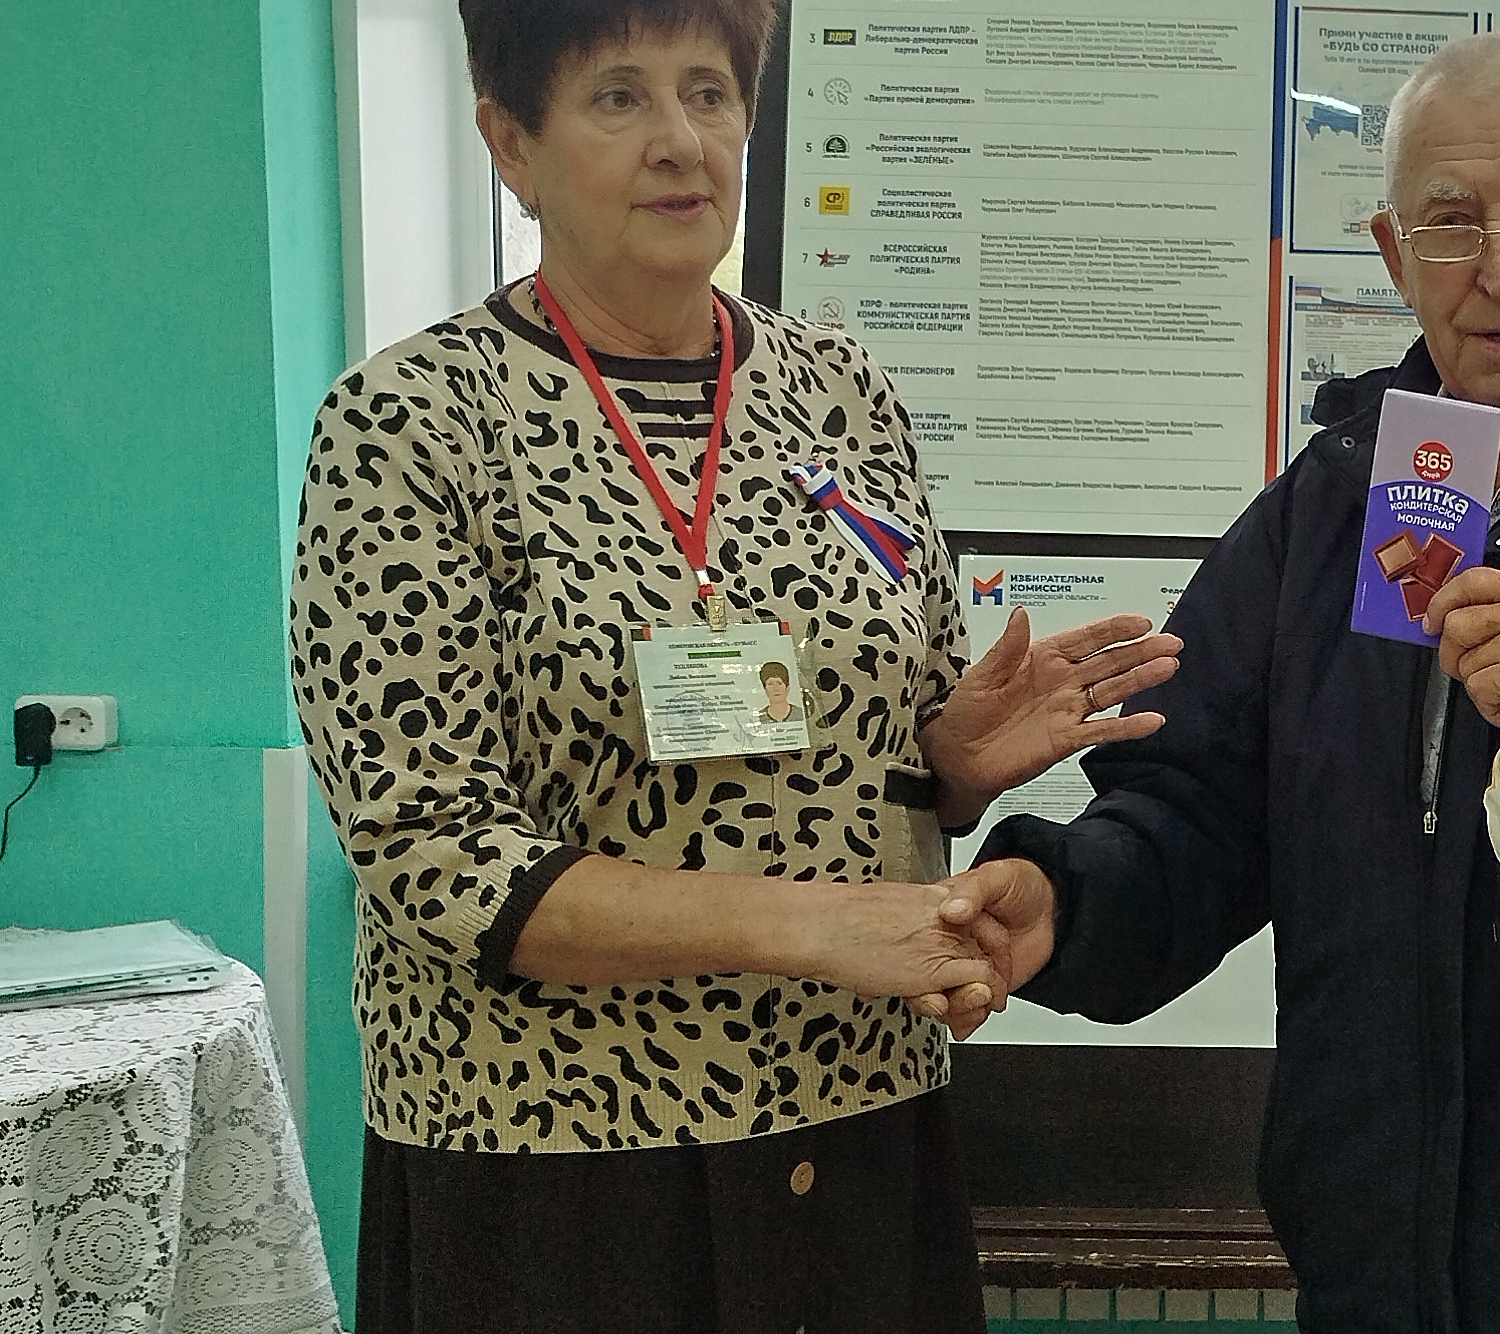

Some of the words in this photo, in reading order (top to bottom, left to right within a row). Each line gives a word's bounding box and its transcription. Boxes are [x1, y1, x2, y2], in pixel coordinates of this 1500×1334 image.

[948, 25, 970, 34] ЛДПР
[1318, 27, 1356, 38] Прими
[1358, 30, 1404, 40] участие
[1414, 34, 1448, 42] акции
[809, 33, 816, 44] 3
[1322, 41, 1360, 52] «БУДЬ
[1361, 42, 1379, 52] СО
[807, 89, 814, 98] 4
[805, 143, 813, 153] 5
[803, 197, 811, 208] 6
[869, 209, 931, 219] СПРАВЕДЛИВАЯ
[931, 210, 962, 220] РОССИЯ
[882, 243, 948, 253] ВСЕРОССИЙСКАЯ
[802, 253, 809, 264] 7
[869, 254, 930, 264] ПОЛИТИЧЕСКАЯ
[930, 255, 961, 264] ПАРТИЯ
[894, 266, 935, 275] «РОДИНА»
[1356, 287, 1401, 298] ПАМЯТК
[859, 299, 883, 308] КПРФ
[856, 309, 940, 320] КОММУНИСТИЧЕСКАЯ
[940, 311, 971, 321] ПАРТИЯ
[863, 320, 915, 330] РОССИЙСКОЙ
[915, 322, 963, 332] ФЕДЕРАЦИИ
[900, 366, 956, 377] ПЕНСИОНЕРОВ
[925, 412, 951, 423] партия
[938, 423, 968, 432] ПАРТИЯ
[923, 434, 955, 443] РОССИИ
[1415, 450, 1452, 472] 365
[1390, 501, 1463, 524] КОНДИТЕРСКАЯ
[1397, 513, 1455, 532] МОЛОЧНАЯ
[1010, 574, 1105, 584] ИЗБИРАТЕЛЬНАЯ
[1010, 584, 1072, 593] КОМИССИЯ
[1160, 587, 1185, 595] Феде
